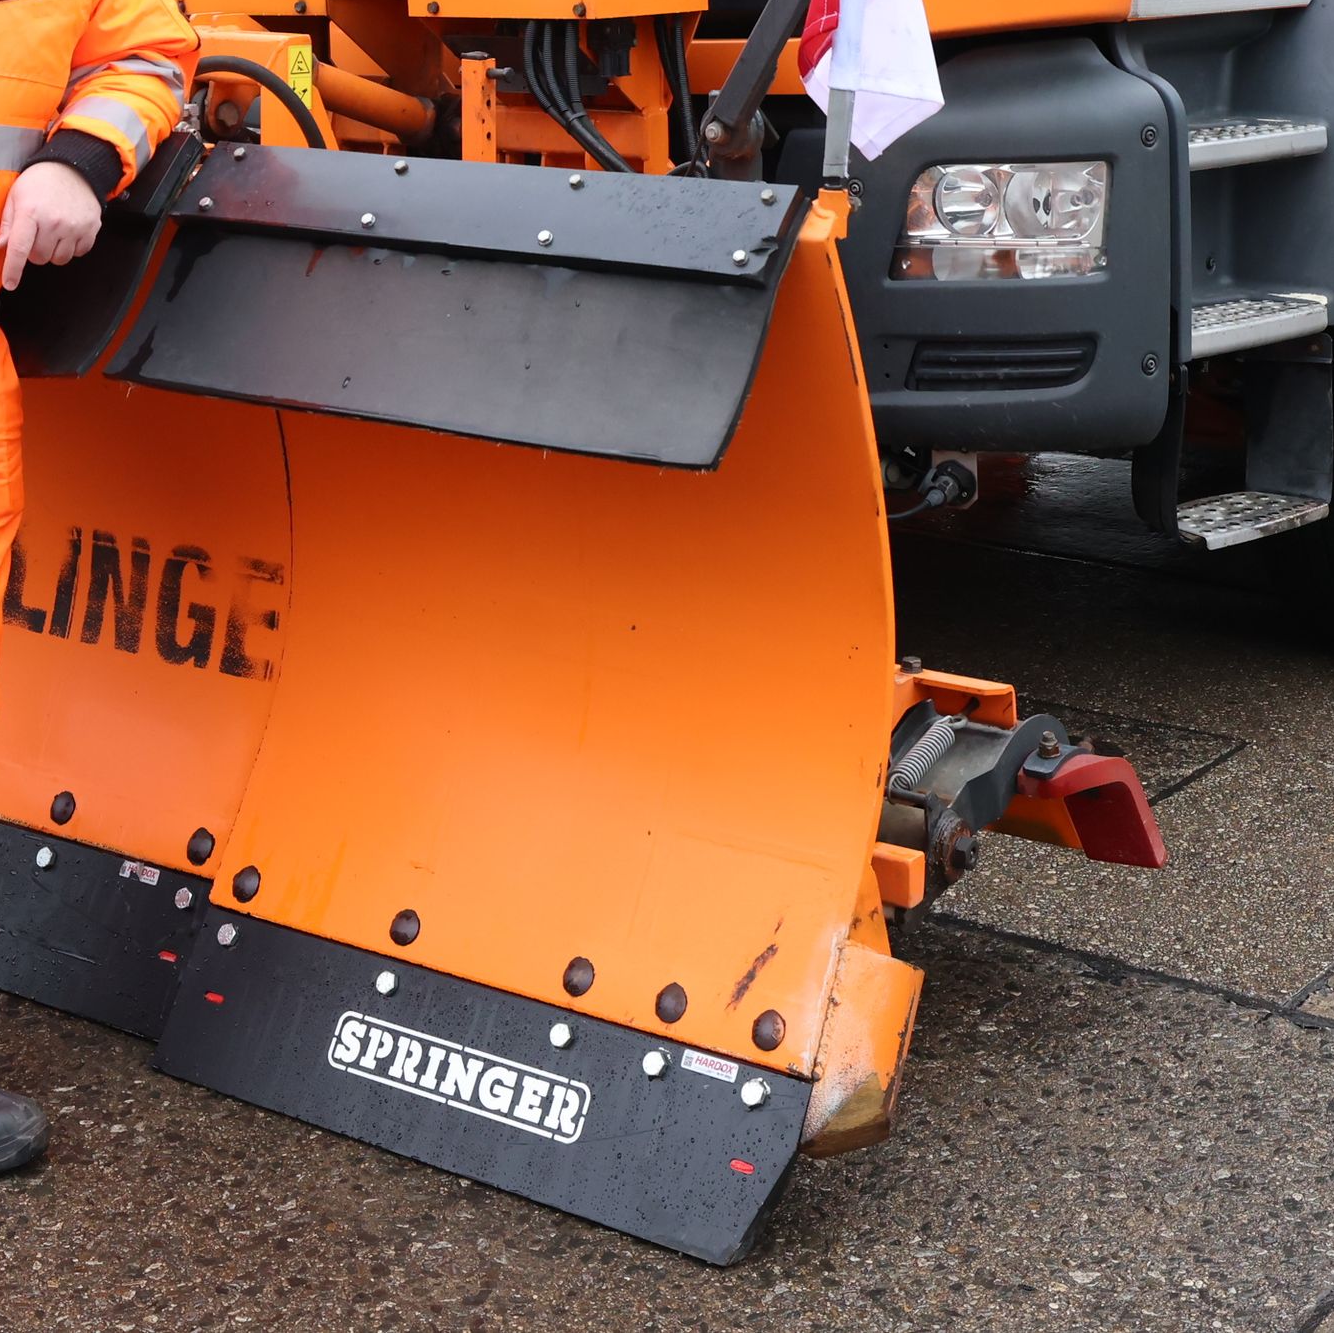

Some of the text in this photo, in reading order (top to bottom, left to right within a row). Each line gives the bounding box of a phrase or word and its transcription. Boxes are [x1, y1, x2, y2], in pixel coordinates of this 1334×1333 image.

[127, 864, 156, 879] HADOX
[694, 1055, 735, 1075] HARDOX
[333, 1019, 581, 1136] SPRINGER
